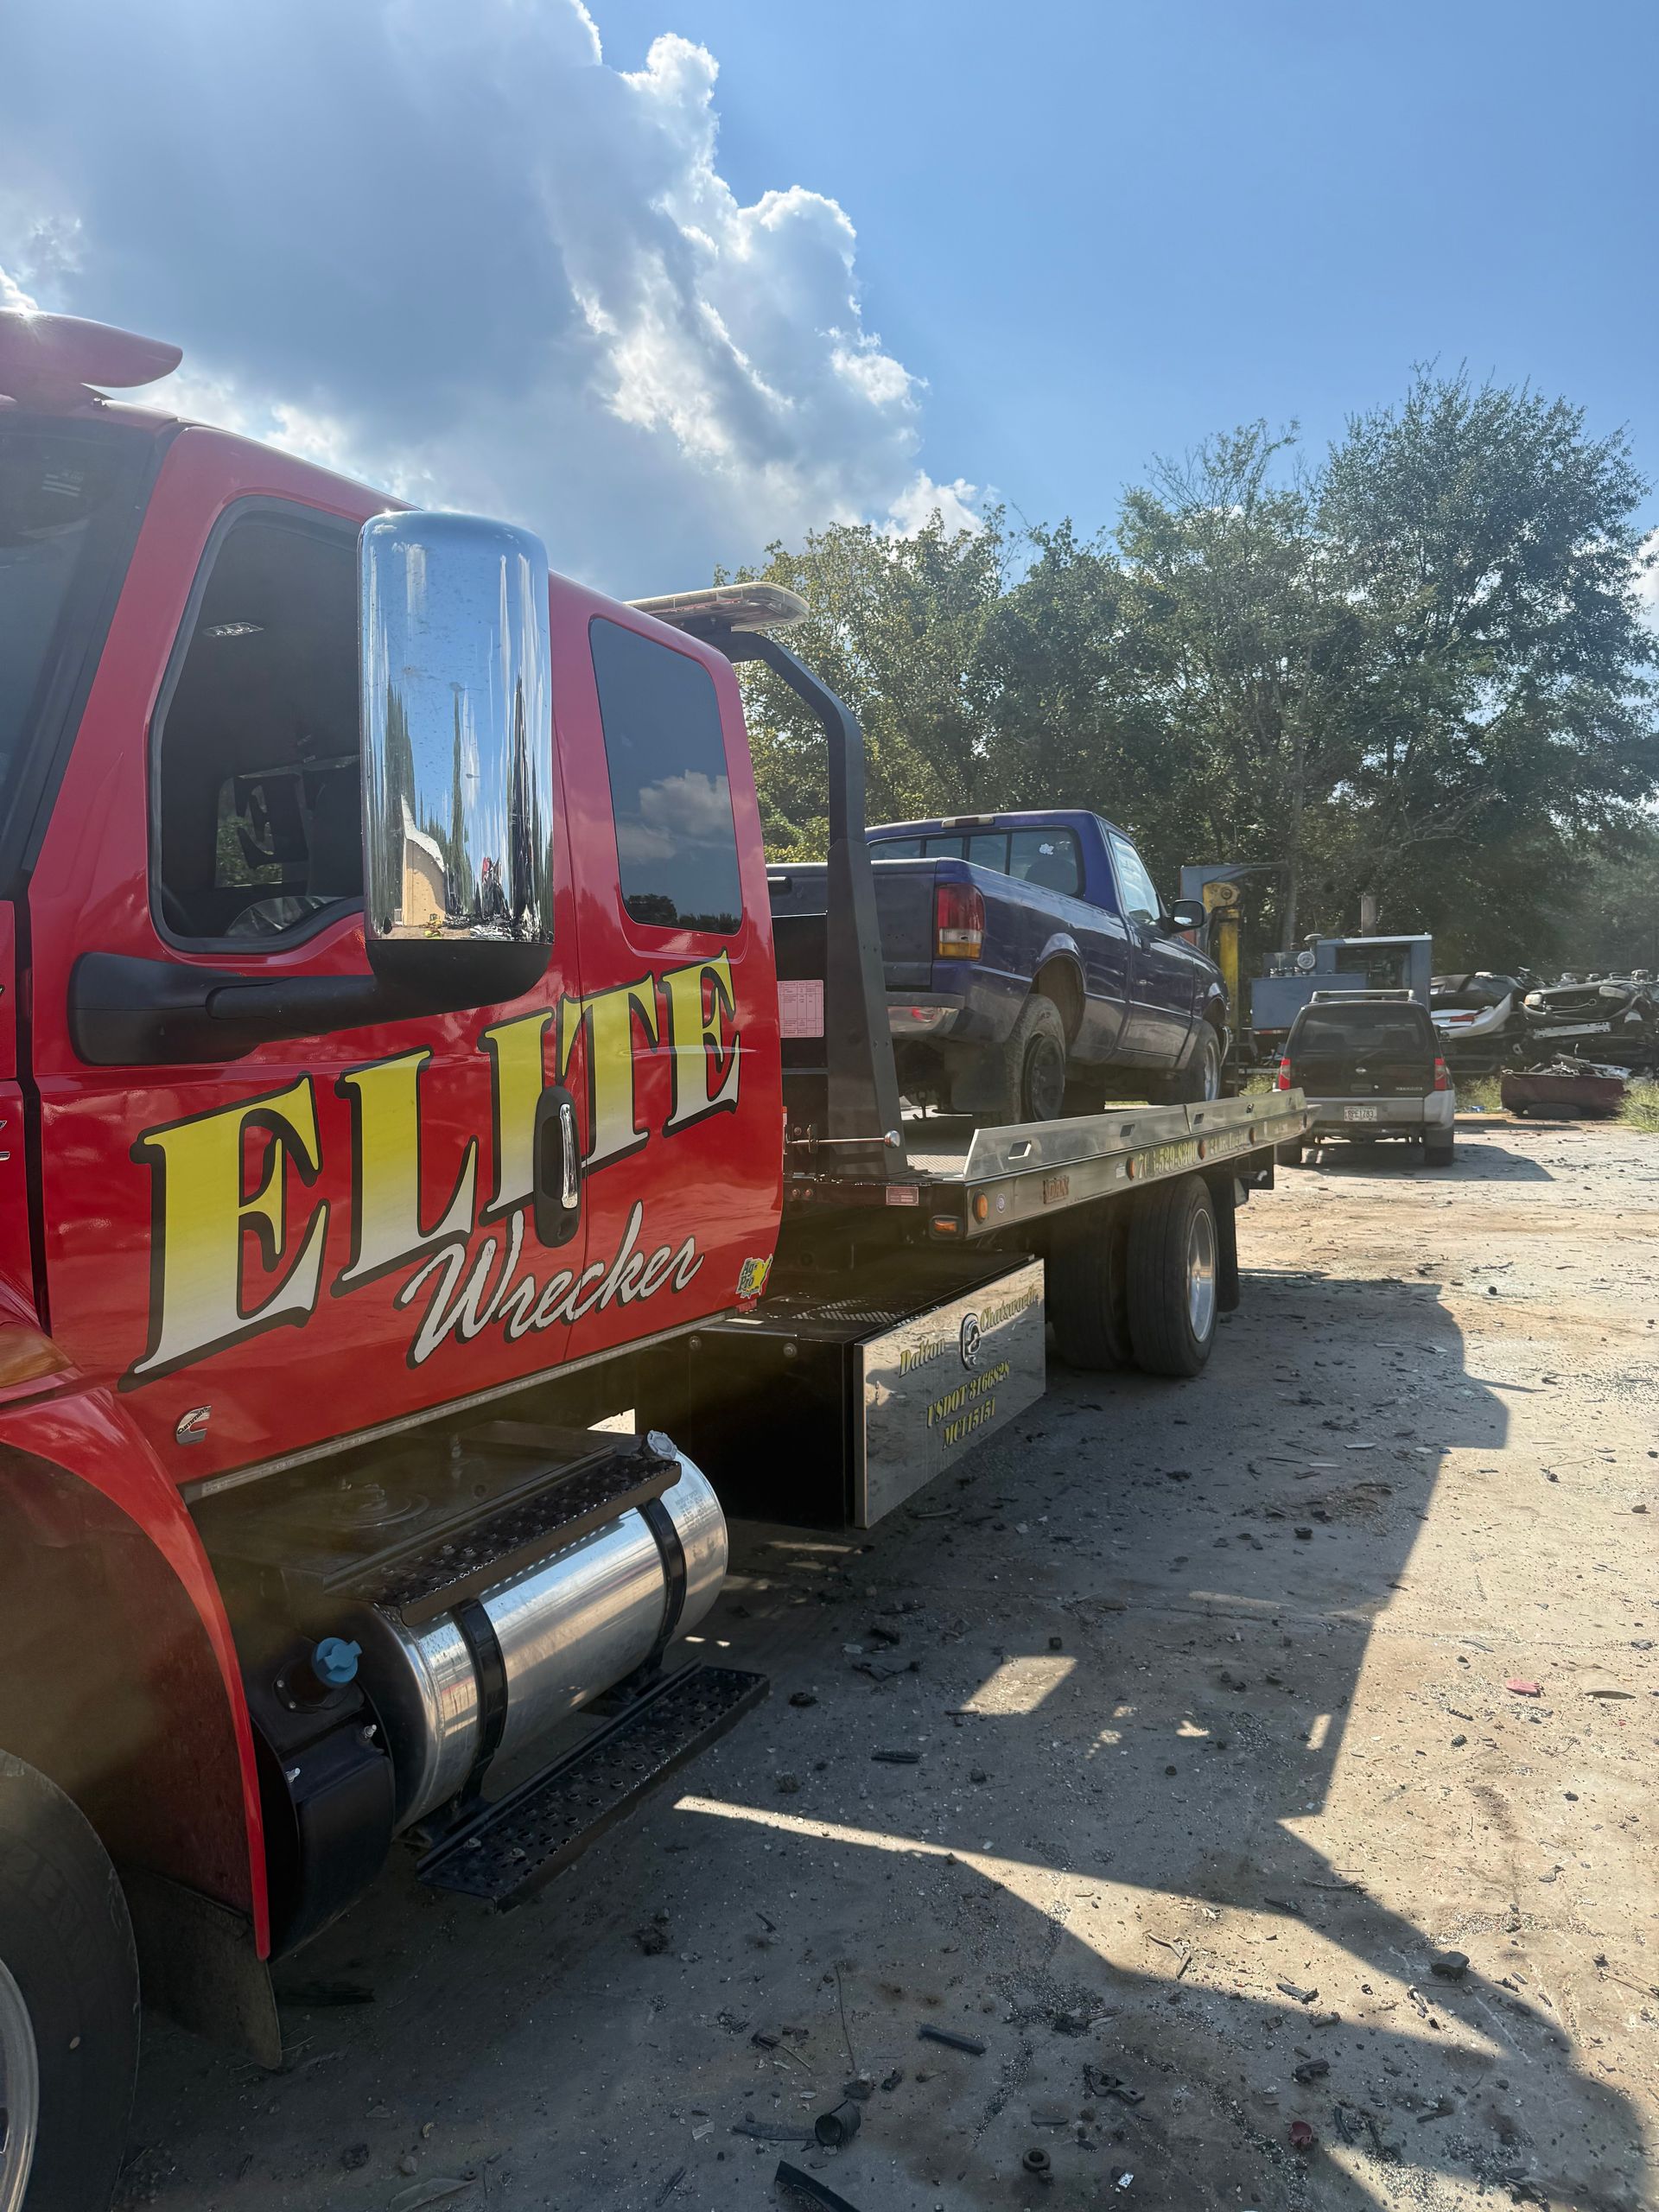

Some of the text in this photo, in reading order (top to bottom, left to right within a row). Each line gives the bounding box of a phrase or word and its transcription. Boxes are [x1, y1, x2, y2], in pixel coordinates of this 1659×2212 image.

[119, 949, 741, 1390] ELITE
[393, 1200, 703, 1368] Wrecker
[899, 1338, 945, 1377] Dalton
[927, 1382, 968, 1428] USDOT
